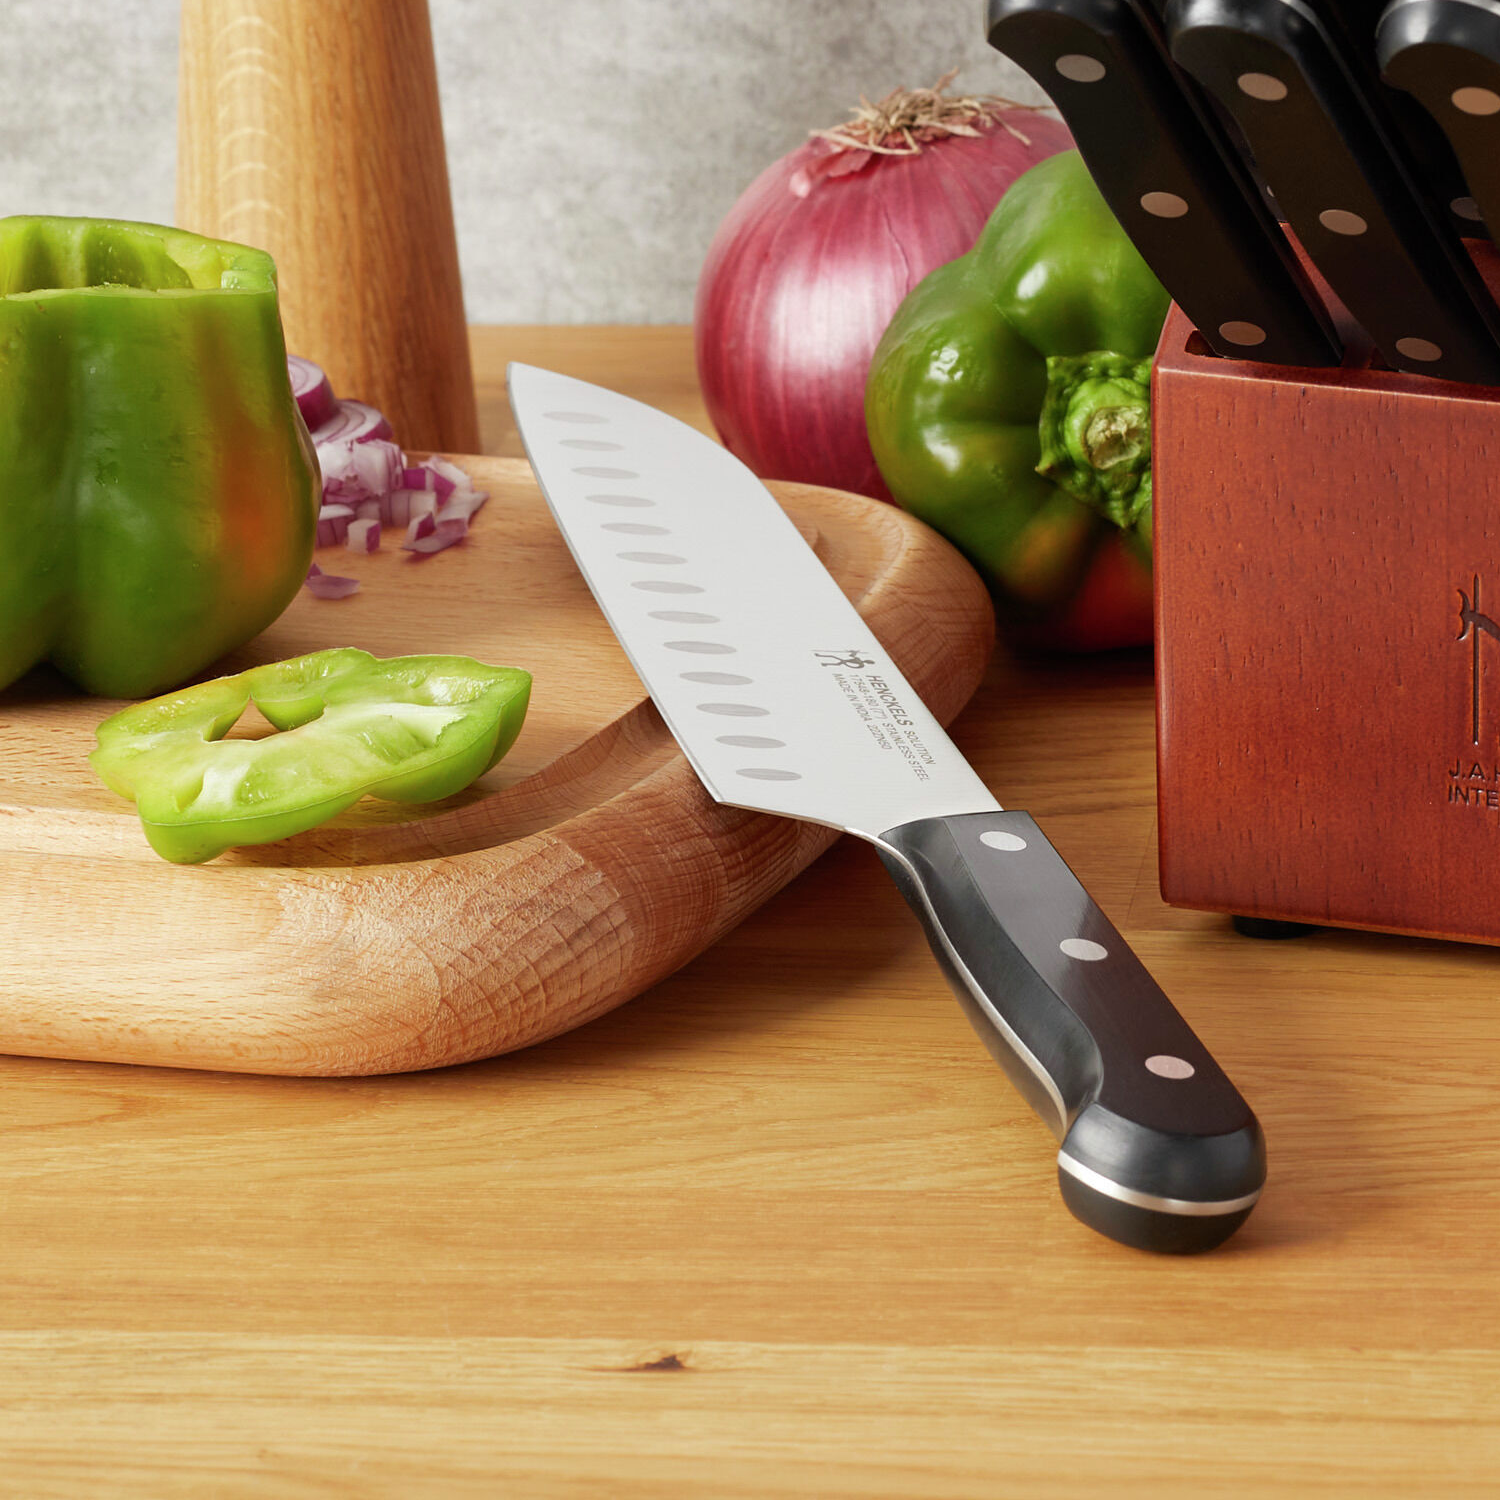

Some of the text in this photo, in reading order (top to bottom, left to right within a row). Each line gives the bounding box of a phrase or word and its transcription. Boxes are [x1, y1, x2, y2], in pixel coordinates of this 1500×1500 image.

[832, 673, 854, 693] MADE
[847, 694, 860, 702] IN
[851, 702, 873, 721] INDIA
[865, 675, 936, 765] HENCKELS SOLUTION
[882, 722, 915, 759] STAINLESS
[908, 760, 930, 781] STEEL
